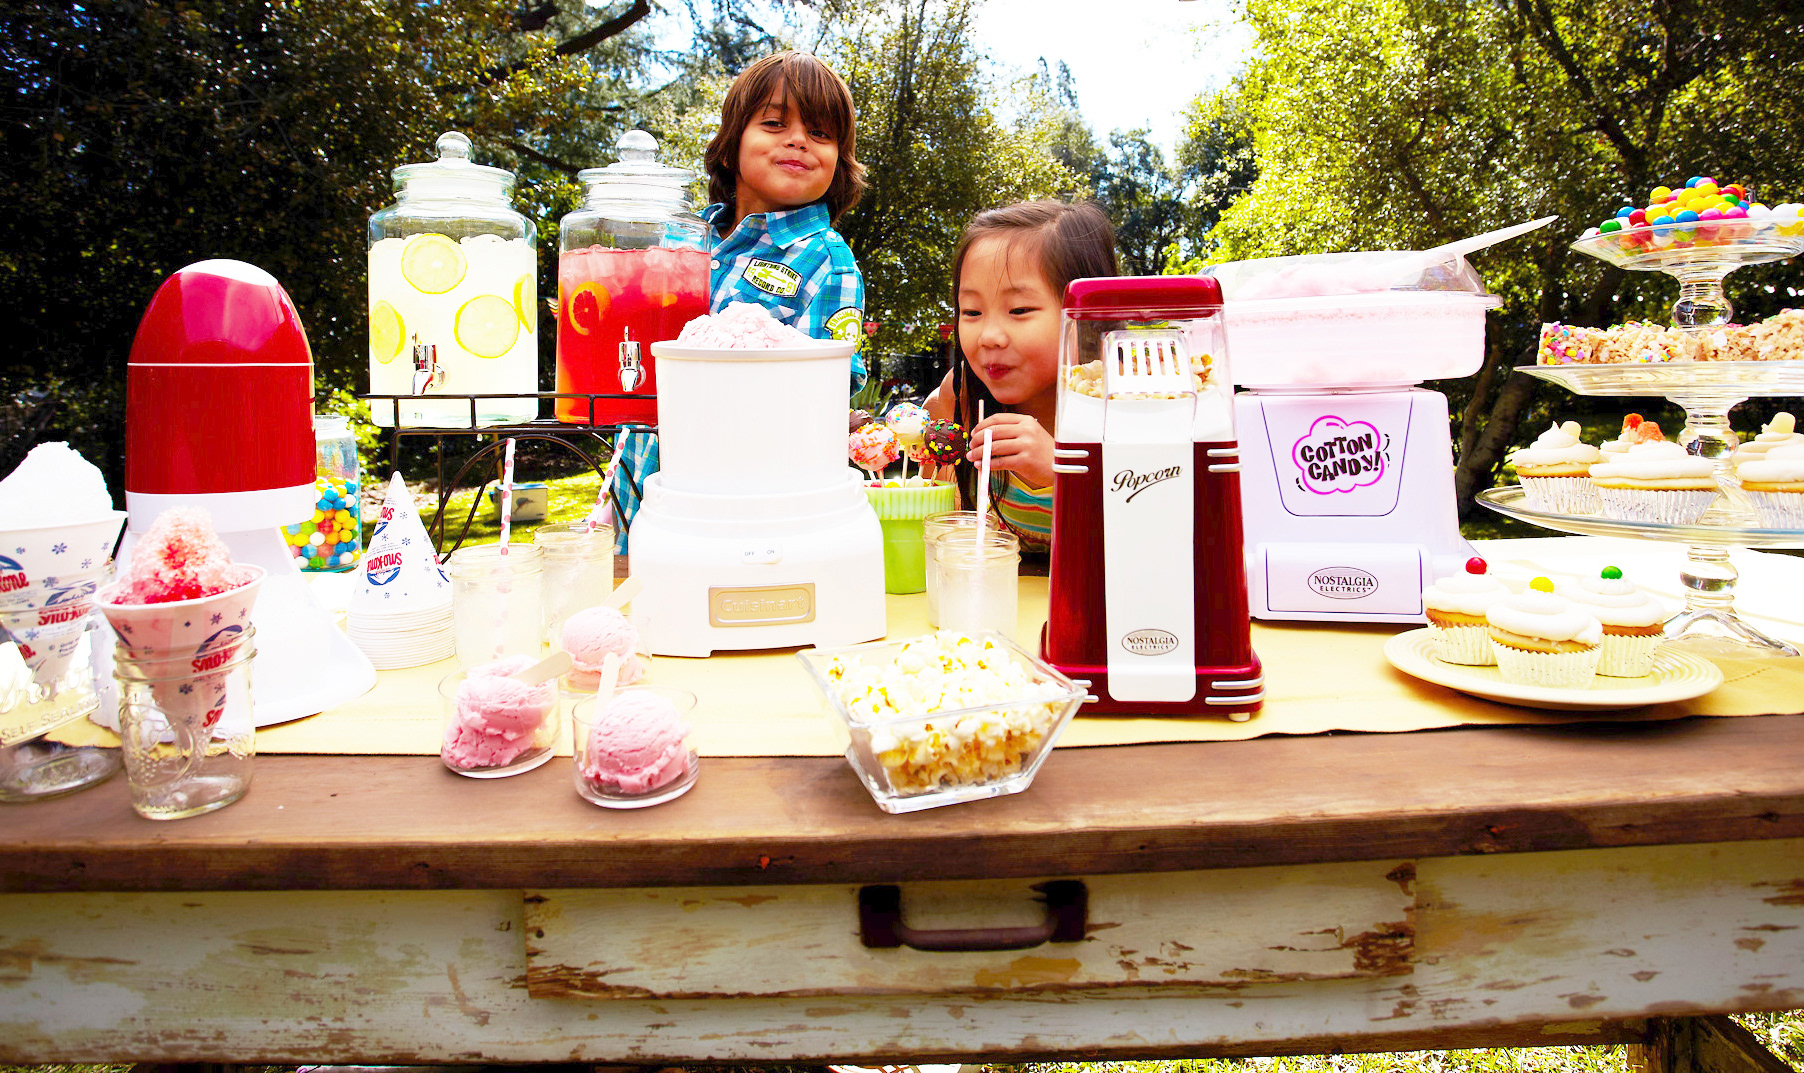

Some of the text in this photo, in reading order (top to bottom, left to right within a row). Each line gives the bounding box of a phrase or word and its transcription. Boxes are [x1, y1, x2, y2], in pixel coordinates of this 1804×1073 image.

[1300, 433, 1373, 463] COTTON
[1307, 451, 1381, 482] CANDY!
[1110, 466, 1183, 494] Popcorn
[1314, 575, 1374, 587] NOSTALGIA
[720, 596, 805, 613] Cuisinart
[1127, 637, 1175, 645] NOSTALGIA
